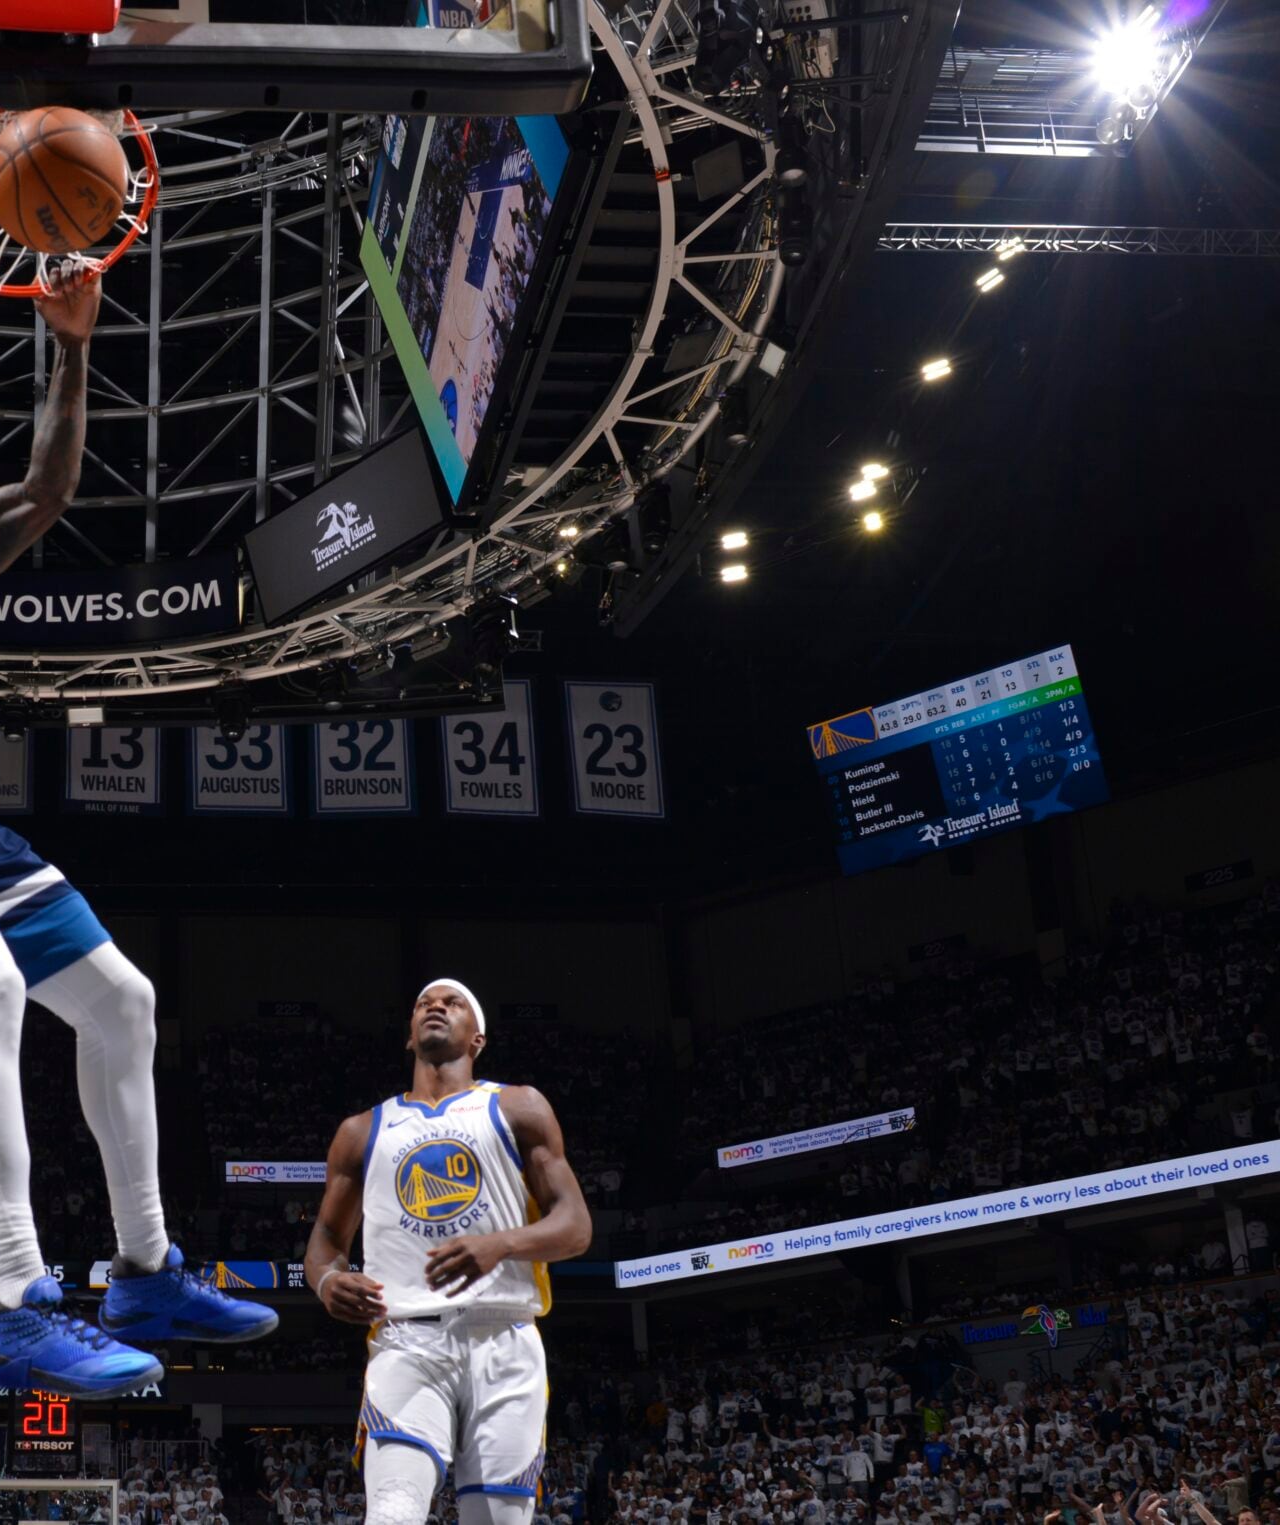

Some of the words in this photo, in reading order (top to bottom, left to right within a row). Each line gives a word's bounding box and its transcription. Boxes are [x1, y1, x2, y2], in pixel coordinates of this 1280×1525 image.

[438, 10, 470, 28] NBA
[311, 540, 346, 567] Treasure
[349, 515, 376, 543] Island
[880, 720, 899, 732] 43.8
[902, 712, 922, 726] 29.0
[926, 704, 947, 717] 63.2
[955, 697, 967, 707] 40
[980, 689, 992, 700] 21
[1005, 681, 1017, 692] 13
[1032, 673, 1039, 683] 7
[1056, 666, 1064, 675] 2
[81, 727, 144, 770] 13
[205, 724, 273, 771] 33
[328, 719, 396, 772] 32
[453, 721, 526, 776] 34
[582, 723, 647, 778] 23
[844, 762, 886, 781] Kuminga
[80, 774, 146, 794] WHALEN
[200, 777, 280, 794] AUGUSTUS
[324, 777, 402, 796] BRUNSON
[460, 781, 523, 799] FOWLES
[590, 781, 646, 800] MOORE
[847, 770, 901, 794] Podziemski
[85, 803, 105, 813] HALL
[107, 804, 118, 813] OF
[119, 804, 140, 814] FAME
[851, 793, 876, 808] Hield
[854, 807, 883, 822] Butler
[883, 802, 894, 814] III
[943, 811, 987, 833] Treasure
[987, 799, 1020, 820] Island
[859, 809, 926, 836] Jackson-Davis
[888, 1114, 908, 1124] BEST
[392, 1131, 439, 1164] GOLDEN
[444, 1129, 478, 1147] STATE
[723, 1143, 764, 1161] nomo
[231, 1164, 276, 1176] nomo
[445, 1152, 469, 1178] 10
[784, 1233, 832, 1251] Helping
[834, 1225, 872, 1242] family
[875, 1215, 942, 1235] caregivers
[944, 1208, 979, 1223] know
[982, 1200, 1017, 1216] more
[1020, 1196, 1030, 1209] &
[1032, 1190, 1072, 1209] worry
[1074, 1185, 1101, 1199] less
[1104, 1175, 1149, 1193] about
[1151, 1167, 1185, 1183] their
[1188, 1158, 1230, 1177] loved
[1233, 1154, 1270, 1170] ones
[399, 1199, 490, 1238] WARRIORS
[691, 1254, 710, 1265] BEST
[728, 1242, 774, 1260] nomo
[619, 1264, 652, 1280] loved
[655, 1262, 681, 1275] ones
[693, 1262, 709, 1271] BUY
[288, 1280, 304, 1288] STL
[22, 1402, 67, 1436] 20
[32, 1441, 75, 1451] TISSOT
